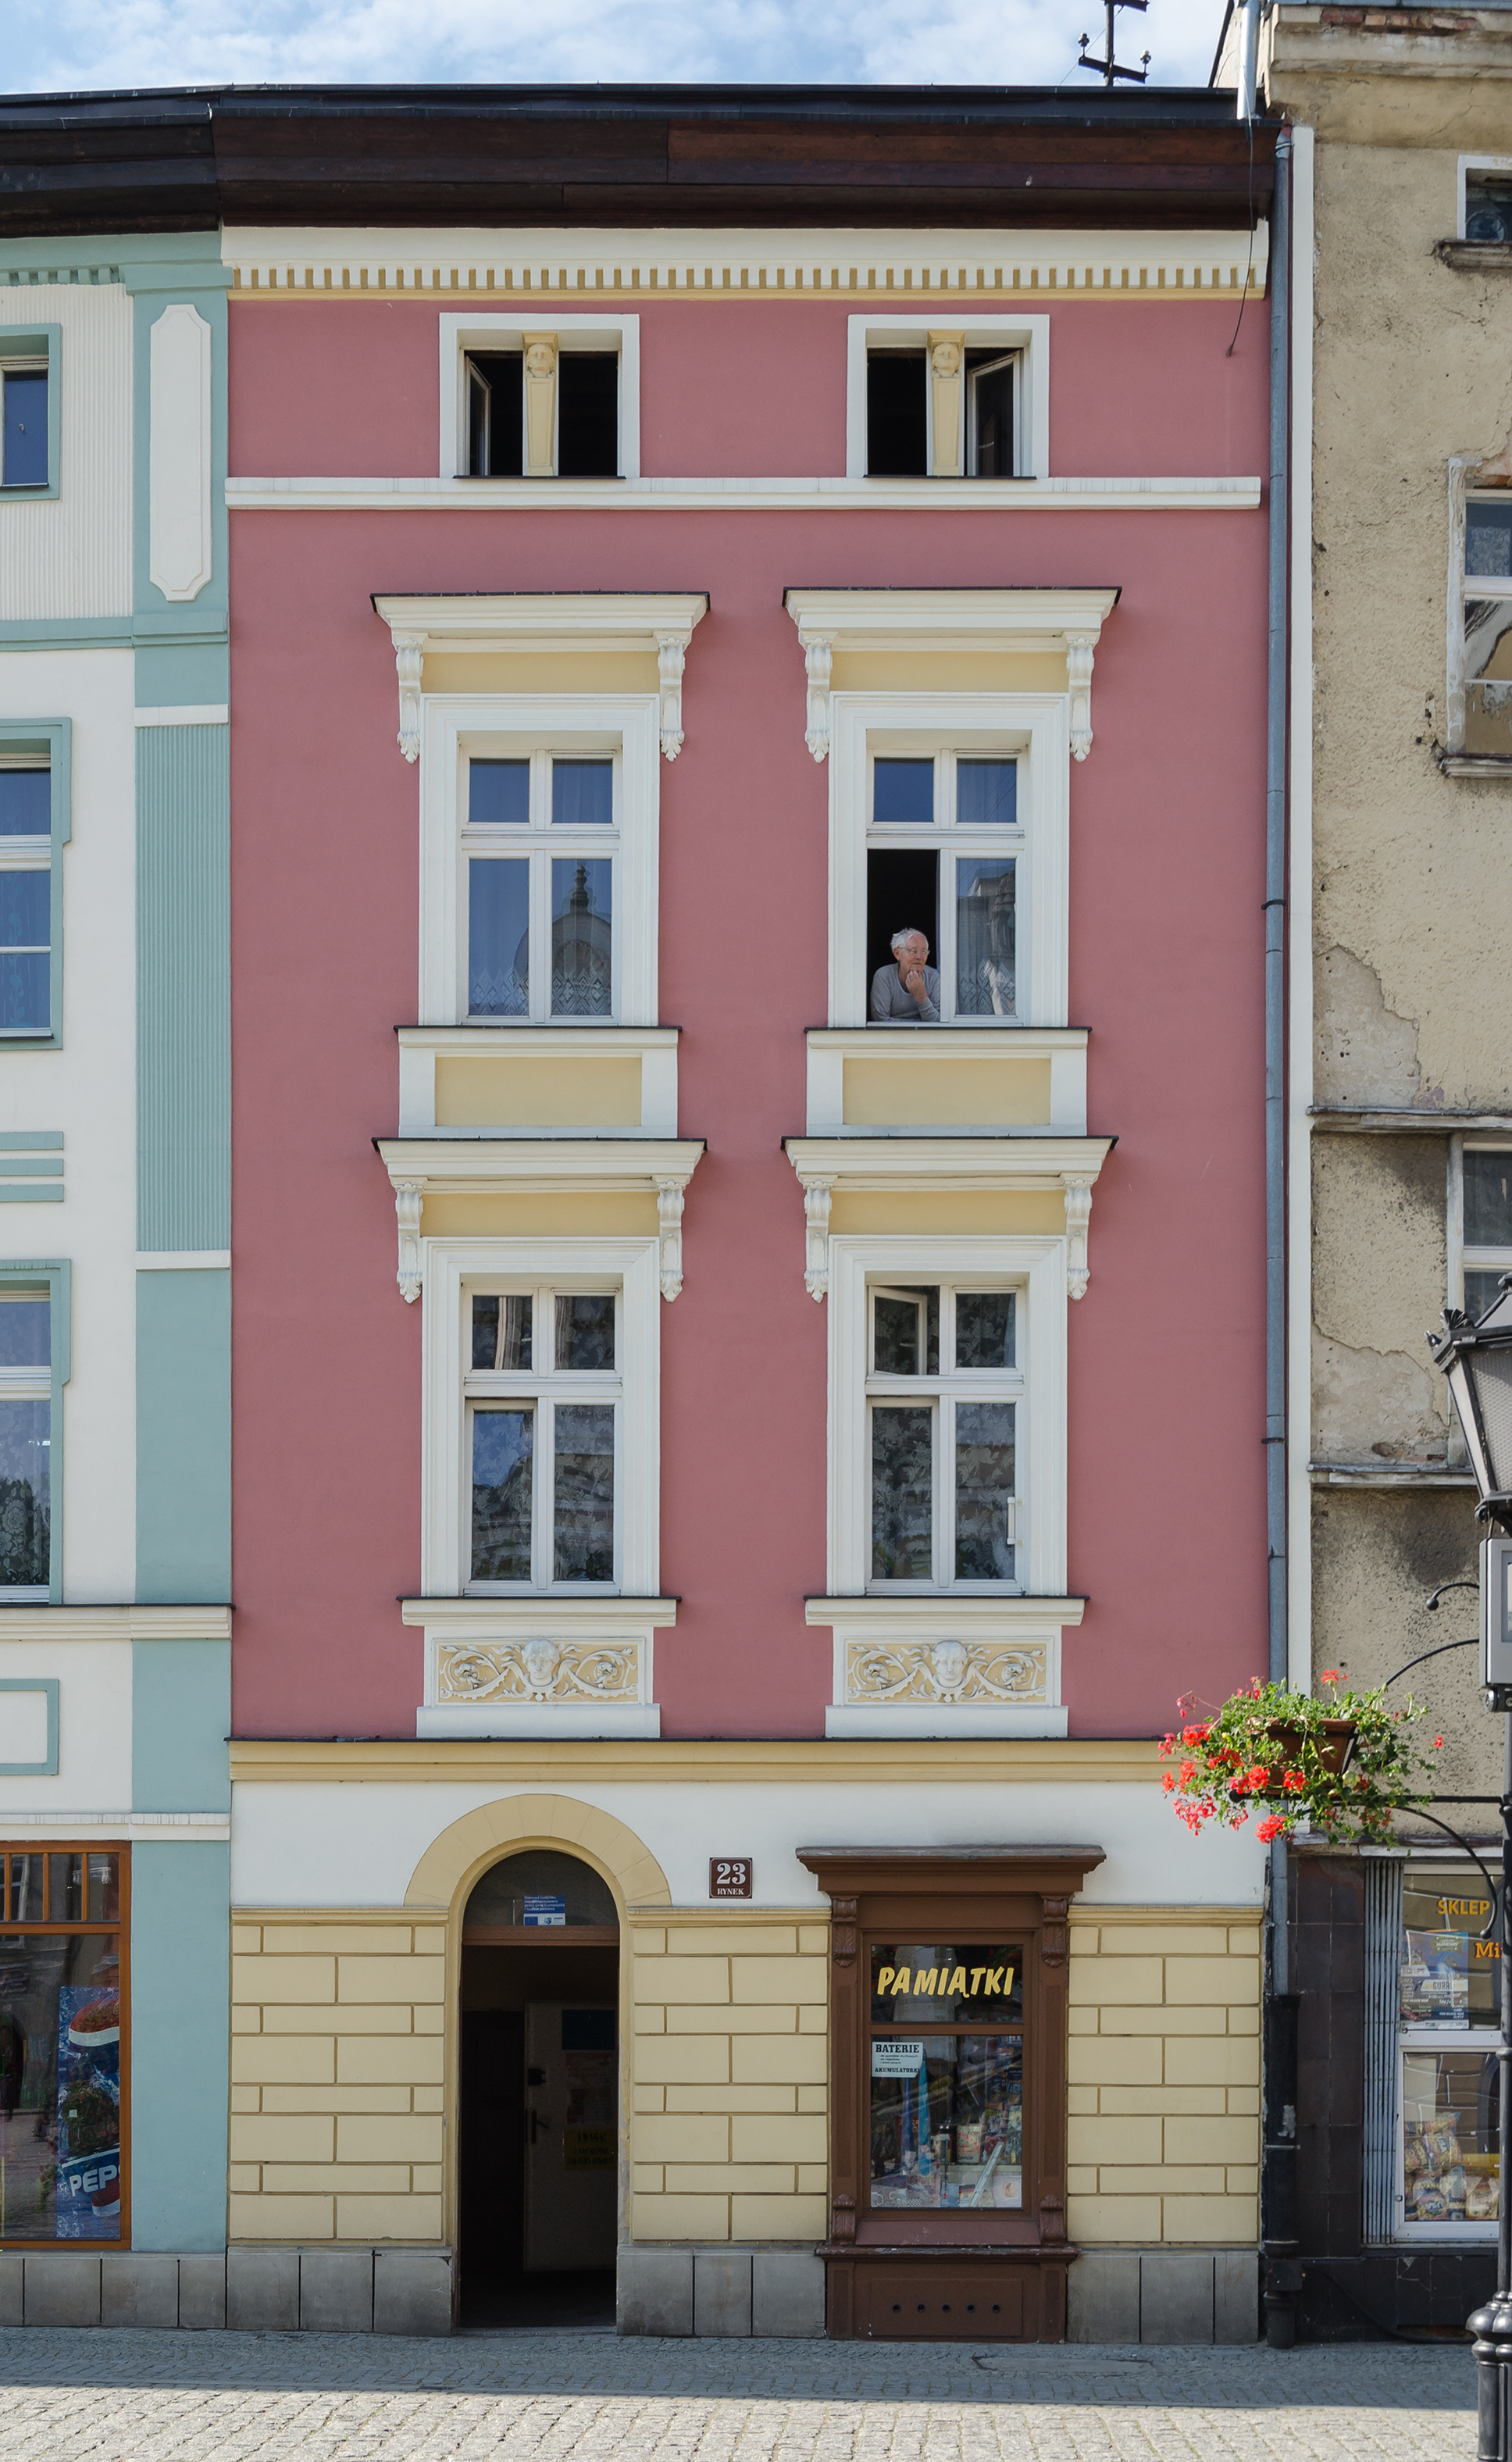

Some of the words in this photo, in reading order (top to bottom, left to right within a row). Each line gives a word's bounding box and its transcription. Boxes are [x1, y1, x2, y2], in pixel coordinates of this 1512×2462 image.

[716, 1862, 746, 1885] 23
[1436, 1900, 1490, 1915] SKLEP
[1475, 1941, 1503, 1959] Mi
[877, 1966, 1015, 1998] PAMIĄTKI
[875, 2044, 919, 2053] BATERIE
[70, 2164, 120, 2197] PEP
